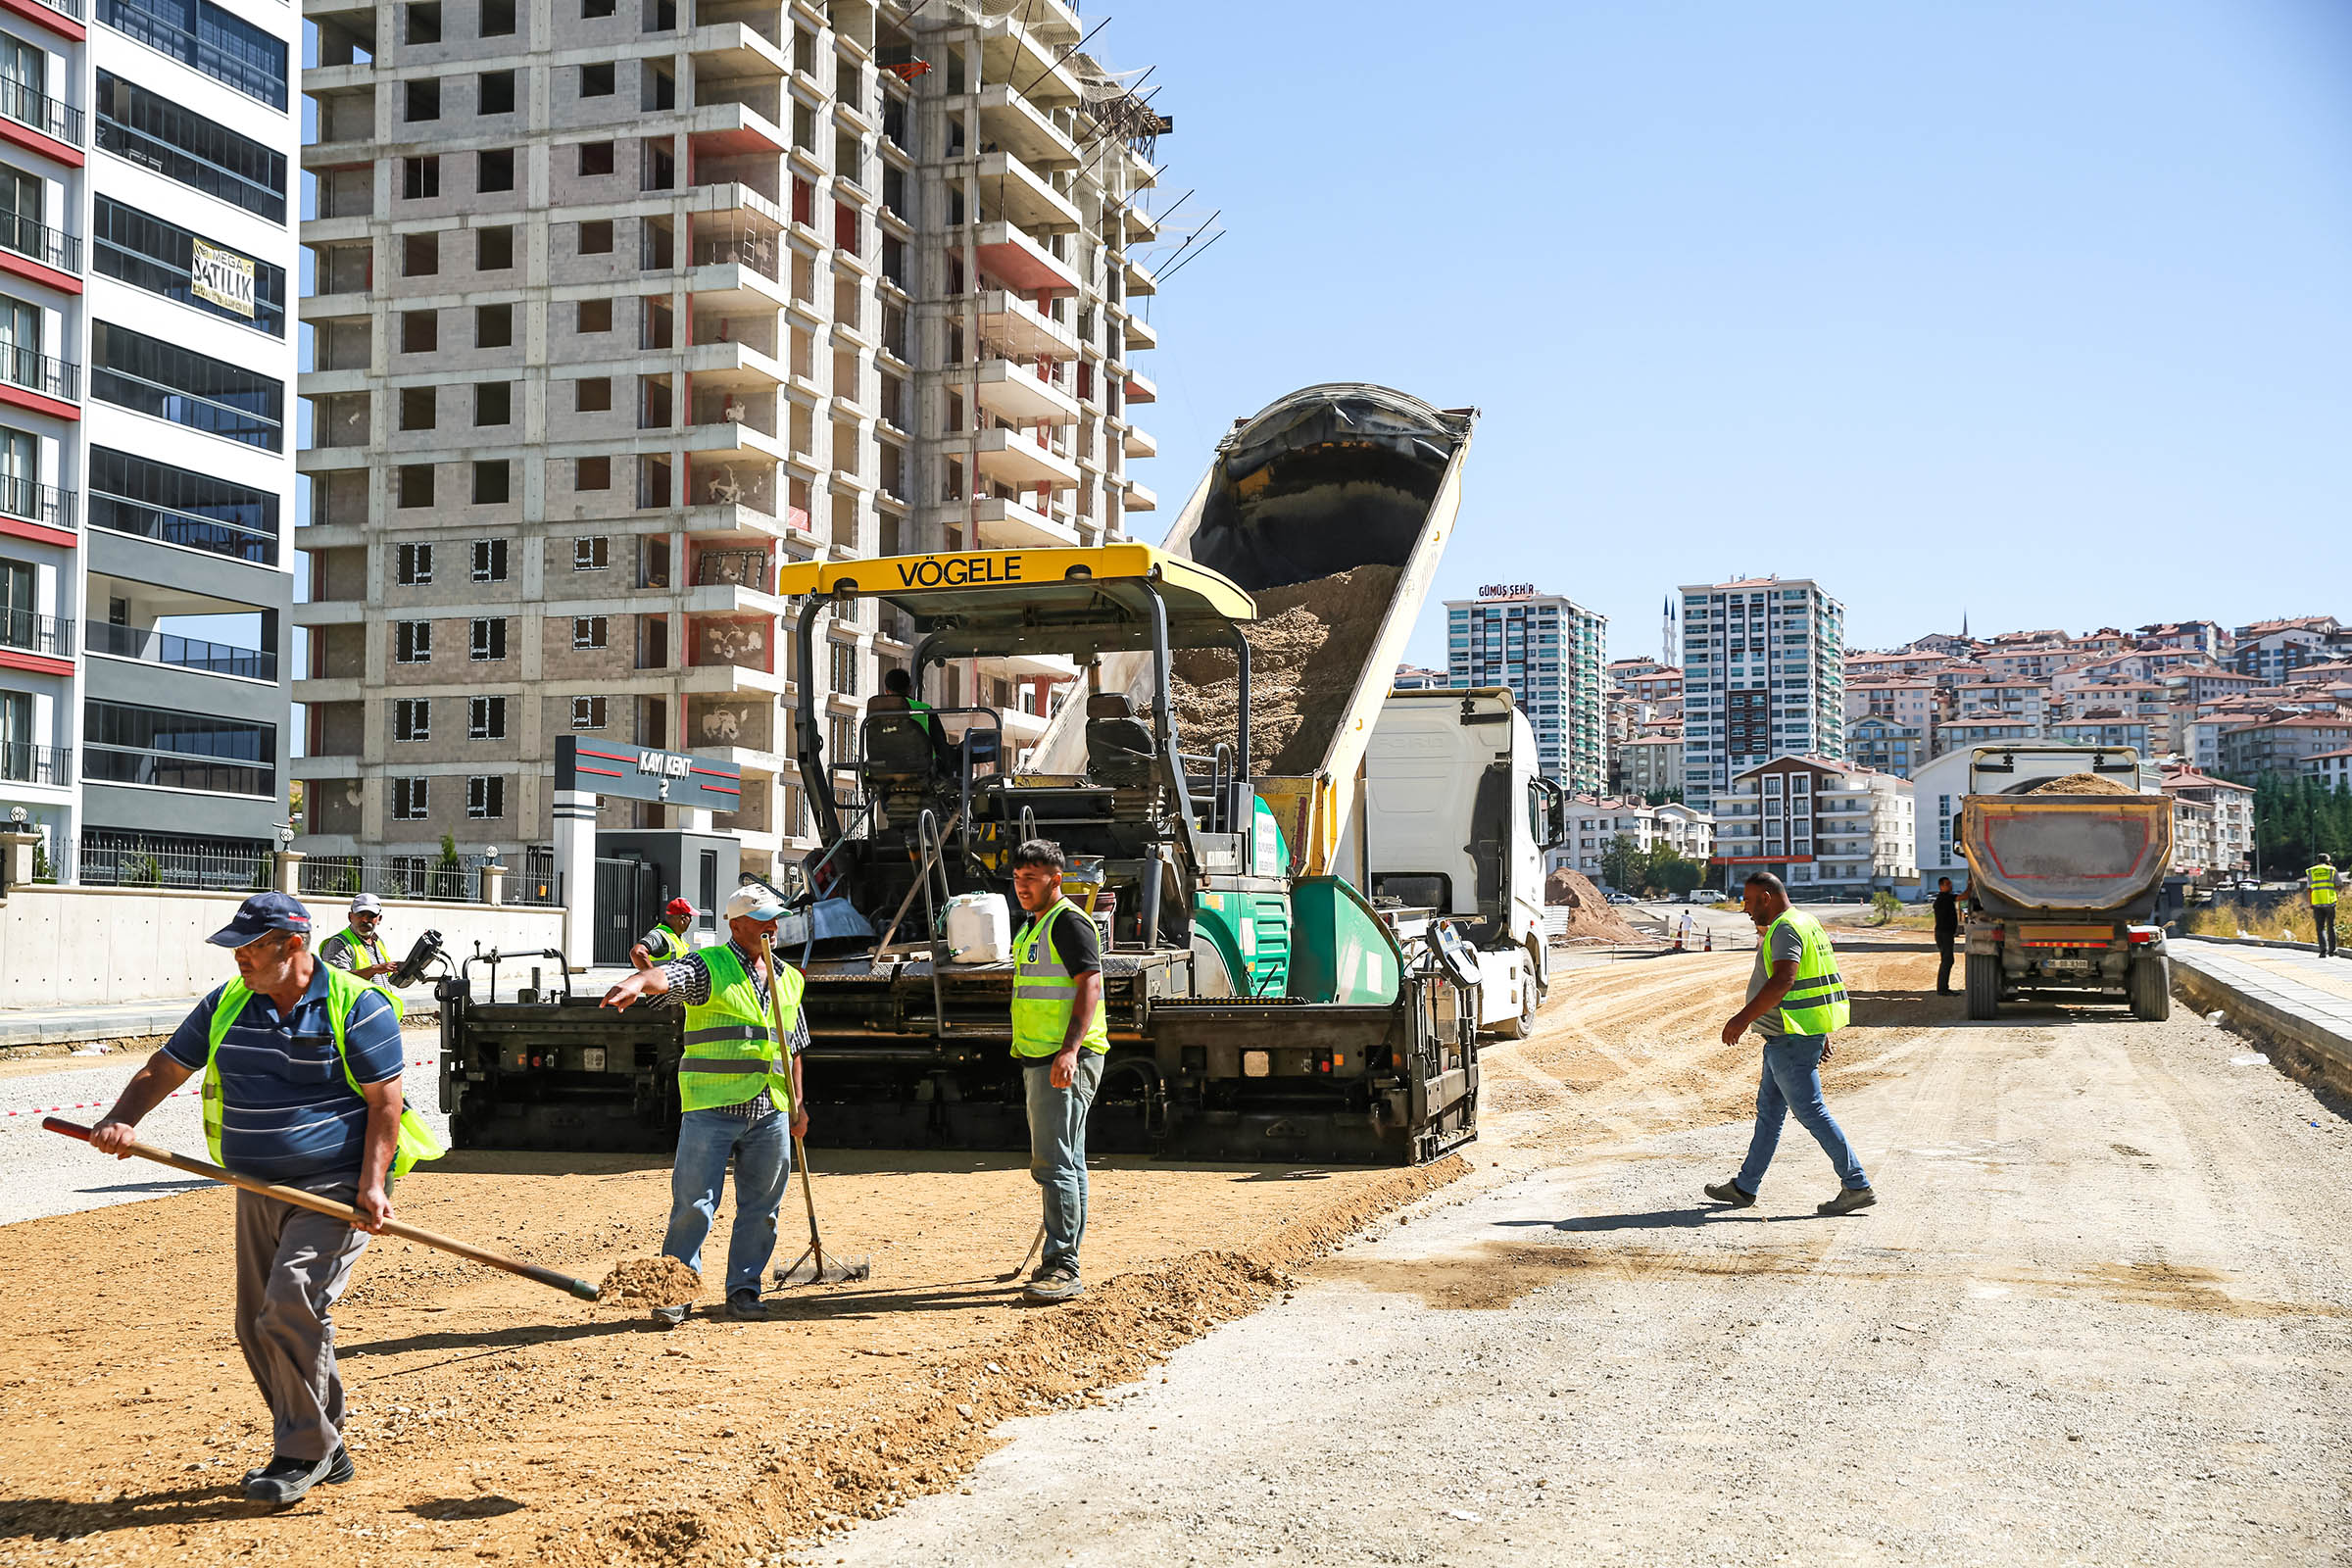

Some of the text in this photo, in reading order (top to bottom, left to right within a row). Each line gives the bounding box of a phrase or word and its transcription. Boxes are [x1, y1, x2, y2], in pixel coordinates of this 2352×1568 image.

[213, 250, 244, 272] MEGA
[897, 556, 1021, 587] VÖGELE
[1479, 583, 1534, 599] GÜMÜŞ ŞEHİR
[639, 751, 692, 777] KAYI KENT
[660, 778, 669, 798] 2
